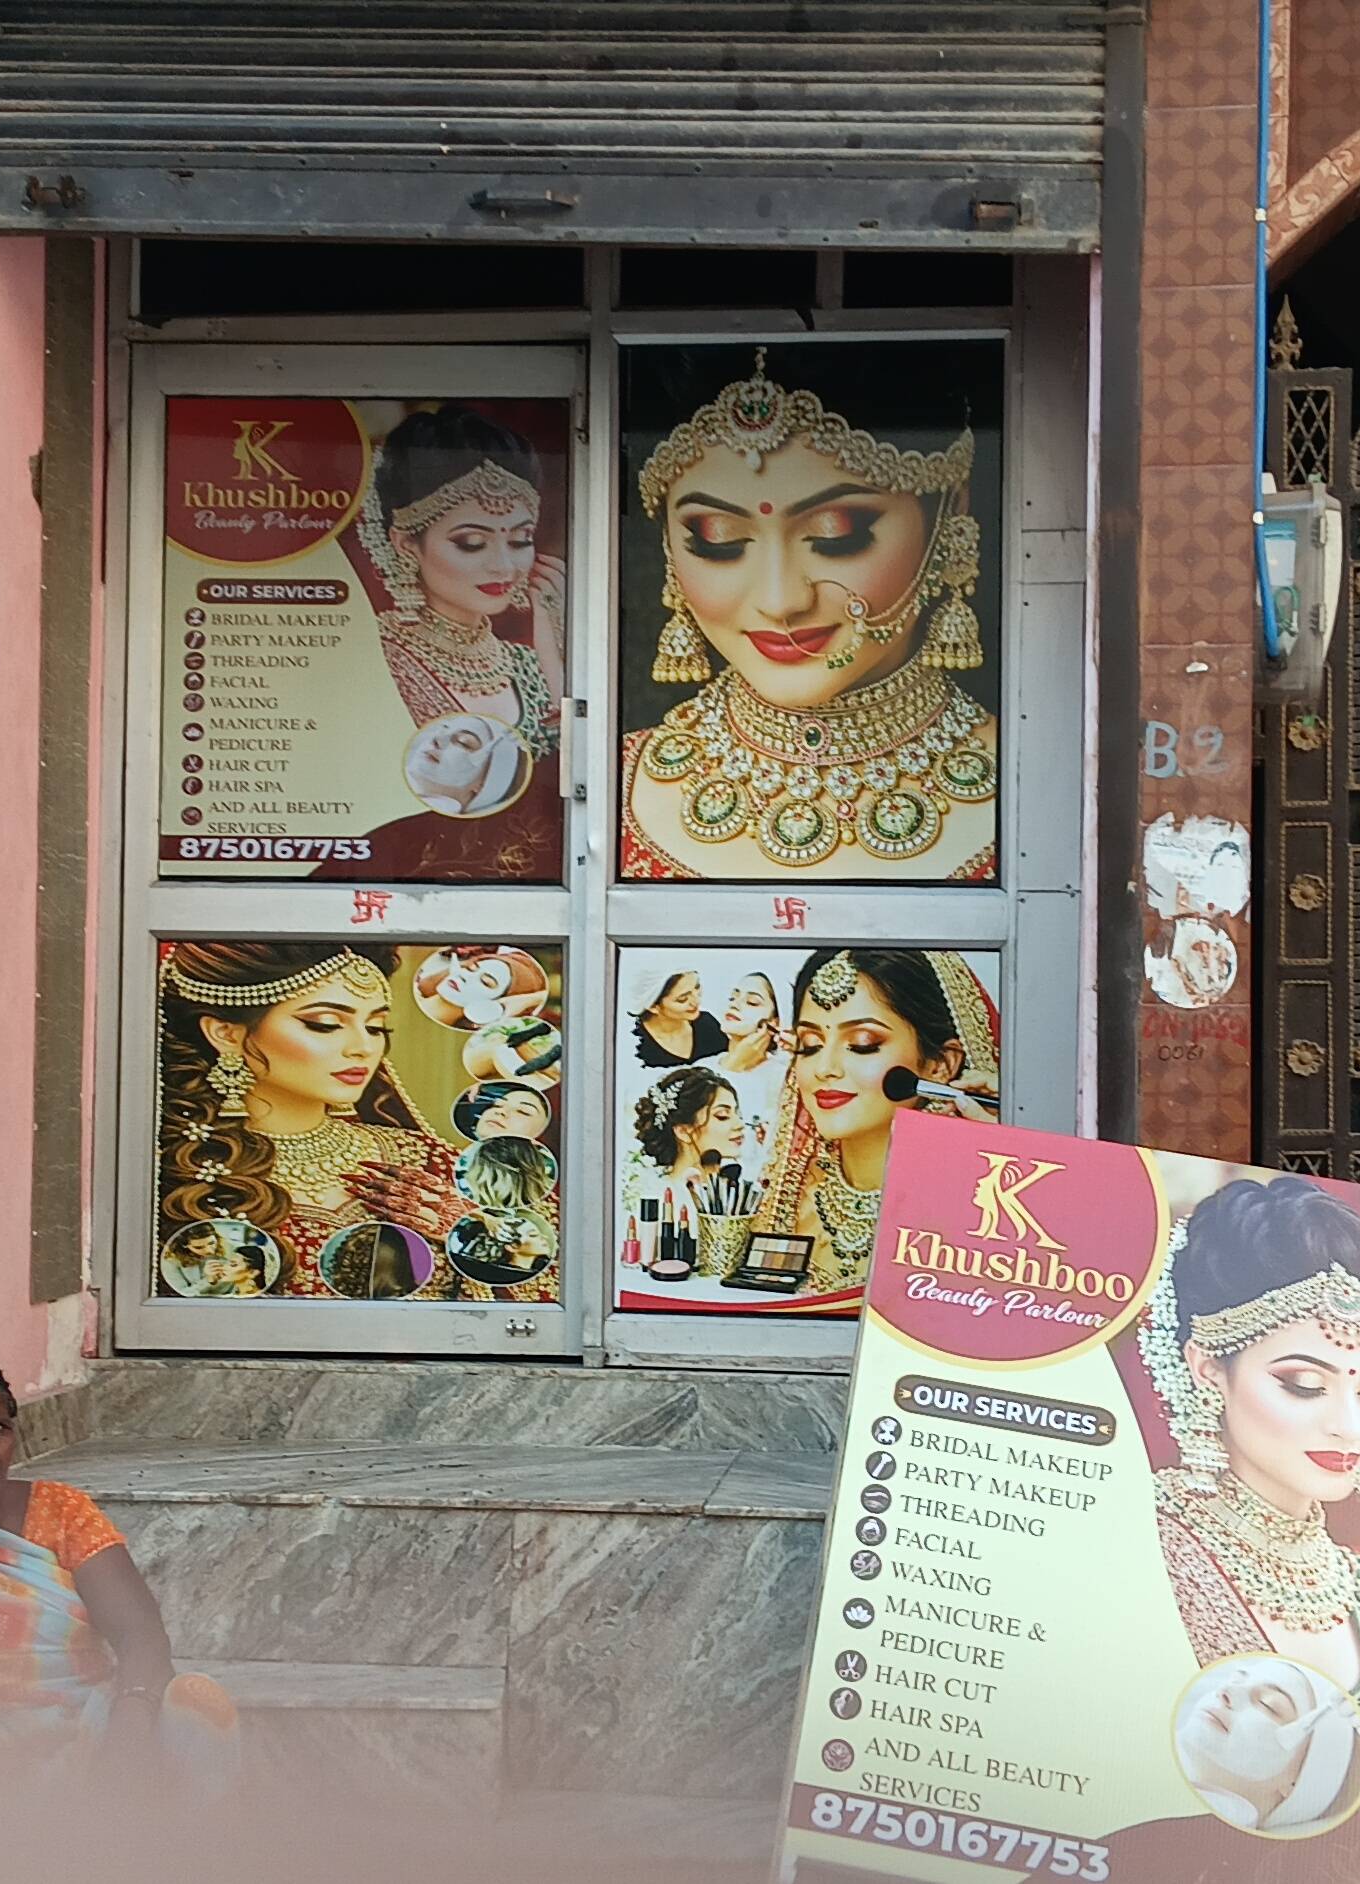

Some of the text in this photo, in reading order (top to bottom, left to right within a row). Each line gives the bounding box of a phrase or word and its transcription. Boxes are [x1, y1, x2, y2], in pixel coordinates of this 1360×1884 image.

[183, 481, 351, 510] Khushboo
[195, 510, 335, 532] Beauty Parlour
[210, 584, 336, 600] OUR SERVICES
[211, 613, 350, 629] BRIDAL MAKEUP
[210, 634, 341, 649] PARTY MAKEUP
[210, 655, 309, 669] THREADING
[210, 676, 269, 690] FACIAL
[210, 697, 278, 711] WAXING
[209, 718, 317, 732] MANICURE &
[208, 738, 292, 752] PEDICURE
[208, 759, 289, 773] HAIR CUT
[208, 780, 284, 794] HAIR SPA
[207, 801, 354, 815] AND ALL BEAUTY
[207, 821, 287, 836] SERVICES
[180, 838, 371, 861] 8750167753
[891, 1226, 1135, 1303] Khushboo
[906, 1273, 1110, 1330] Beauty Parlour
[913, 1384, 1098, 1436] OUR SERVICES
[909, 1429, 1113, 1483] BRIDAL MAKEUP
[903, 1462, 1097, 1513] PARTY MAKEUP
[899, 1493, 1046, 1537] THREADING
[894, 1527, 982, 1560] FACIAL
[890, 1560, 993, 1597] WAXING
[884, 1595, 1048, 1643] MANICURE &
[880, 1629, 1006, 1672] PEDICURE
[875, 1663, 998, 1706] HAIR CUT
[869, 1700, 985, 1740] HAIR SPA
[864, 1736, 1092, 1797] AND ALL BEAUTY
[858, 1771, 982, 1813] SERVICES
[809, 1792, 1111, 1883] 8750167753
